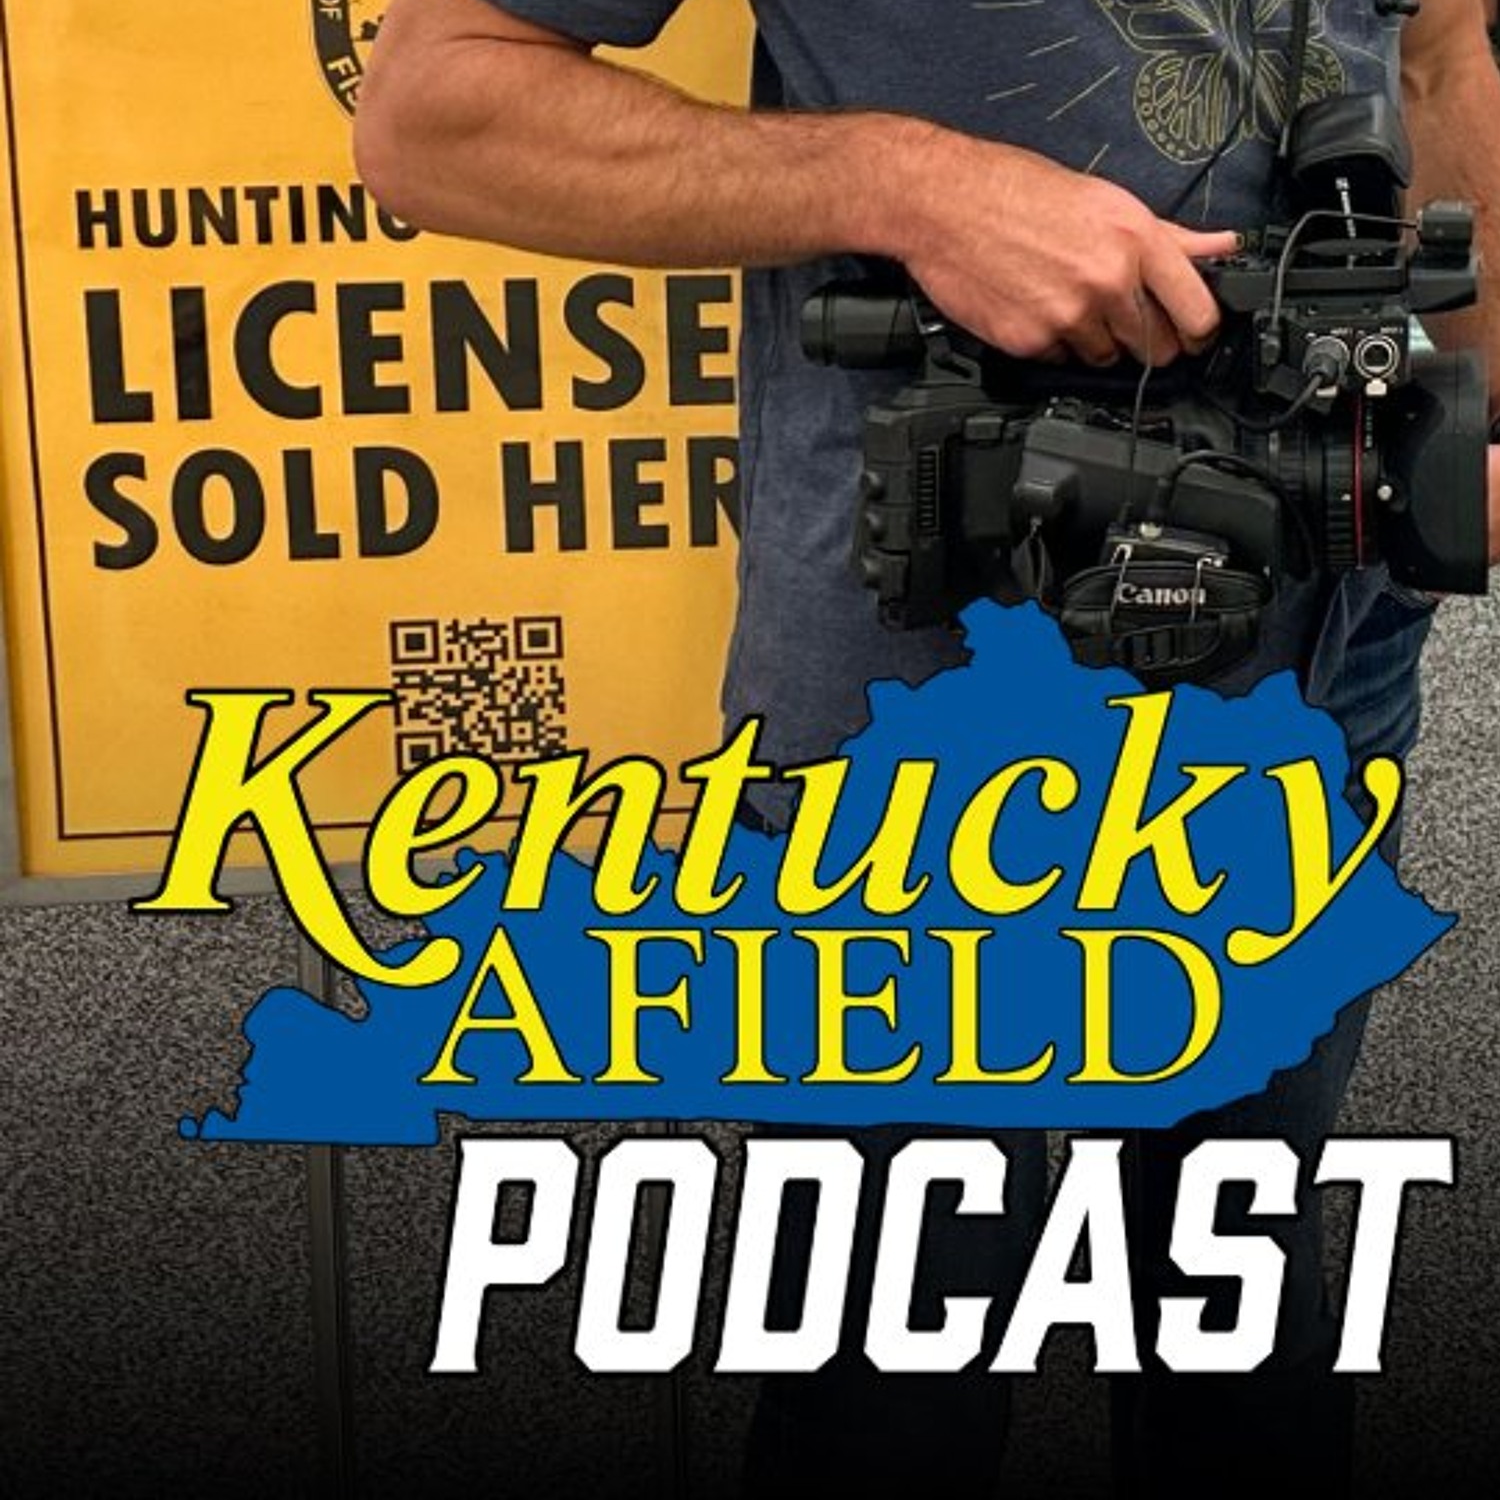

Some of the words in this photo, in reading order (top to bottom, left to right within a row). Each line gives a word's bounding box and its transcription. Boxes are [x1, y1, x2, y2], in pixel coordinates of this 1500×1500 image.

[83, 273, 736, 424] LICENSE
[83, 445, 440, 570] SOLD
[501, 436, 743, 553] HER
[1118, 582, 1207, 605] Canon
